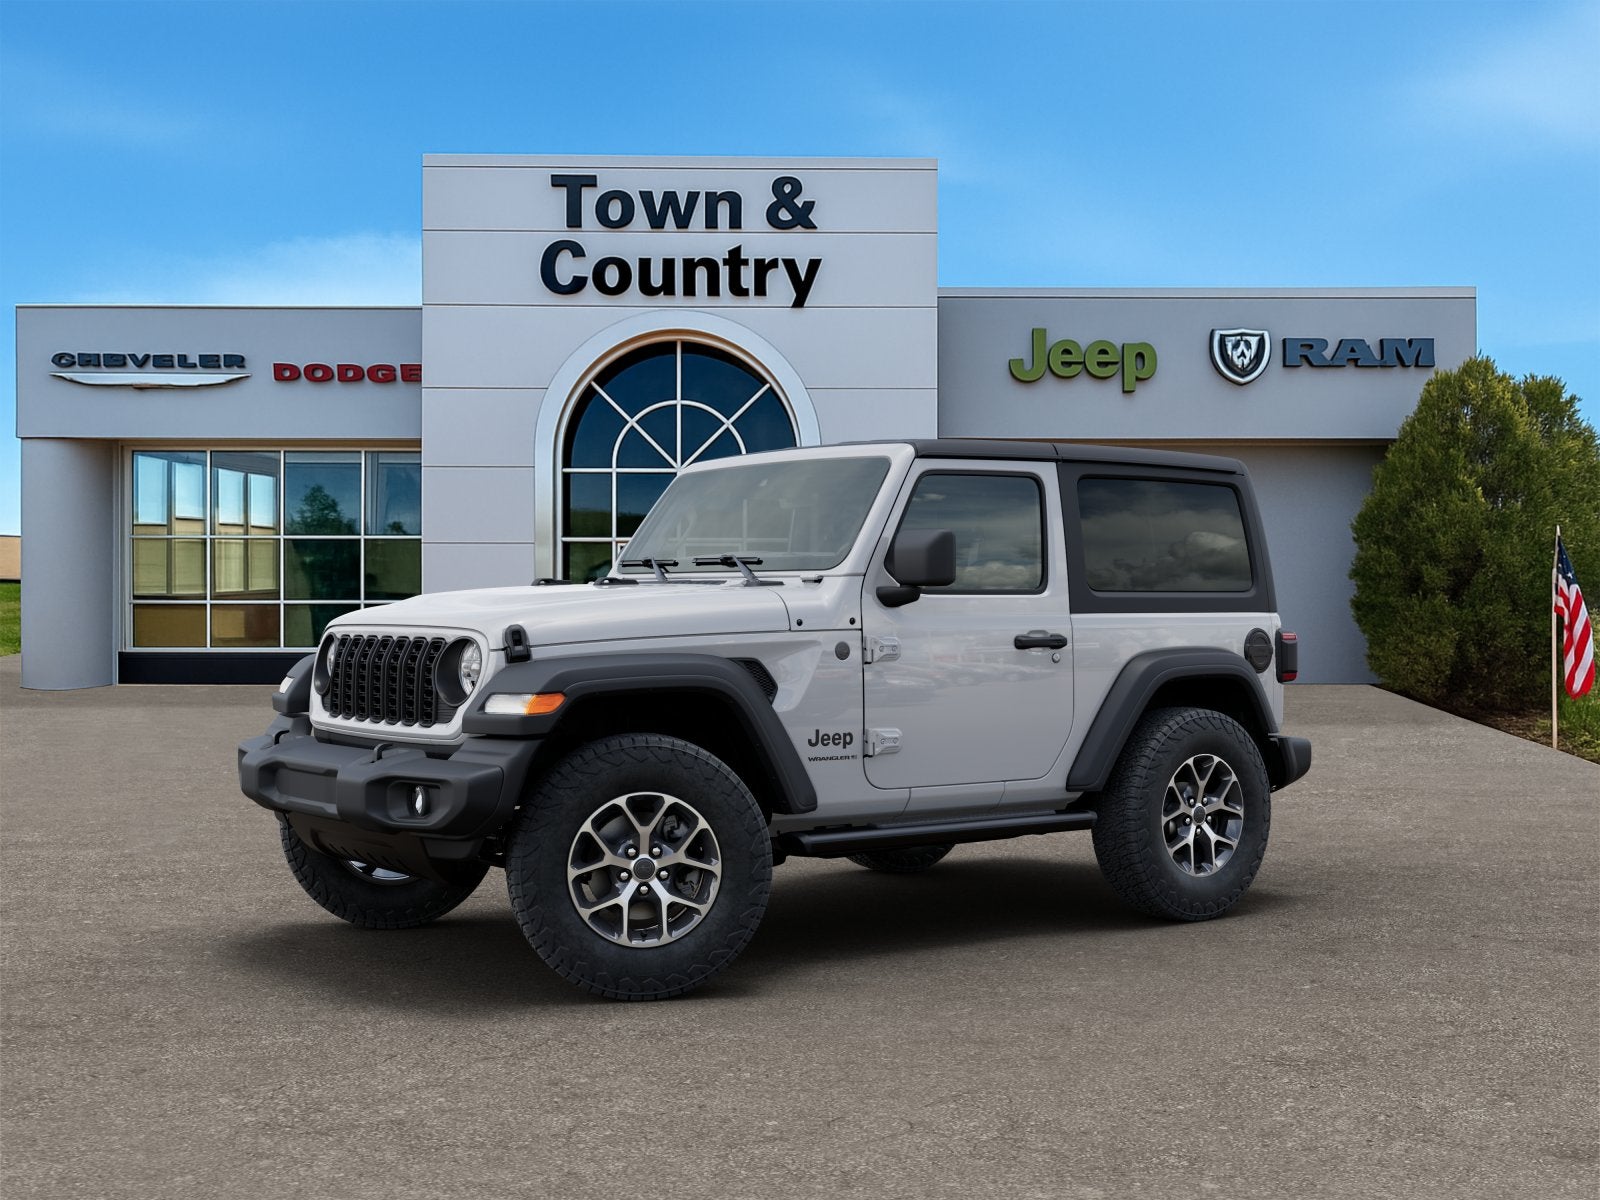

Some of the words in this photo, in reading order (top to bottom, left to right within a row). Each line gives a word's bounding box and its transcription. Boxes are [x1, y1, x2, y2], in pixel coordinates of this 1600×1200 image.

[551, 174, 742, 229] Town
[766, 176, 818, 229] &
[540, 239, 822, 308] Country
[273, 363, 422, 383] DODGE
[1009, 328, 1157, 392] Jeep
[1283, 337, 1436, 368] RAM
[808, 729, 853, 749] Jeep
